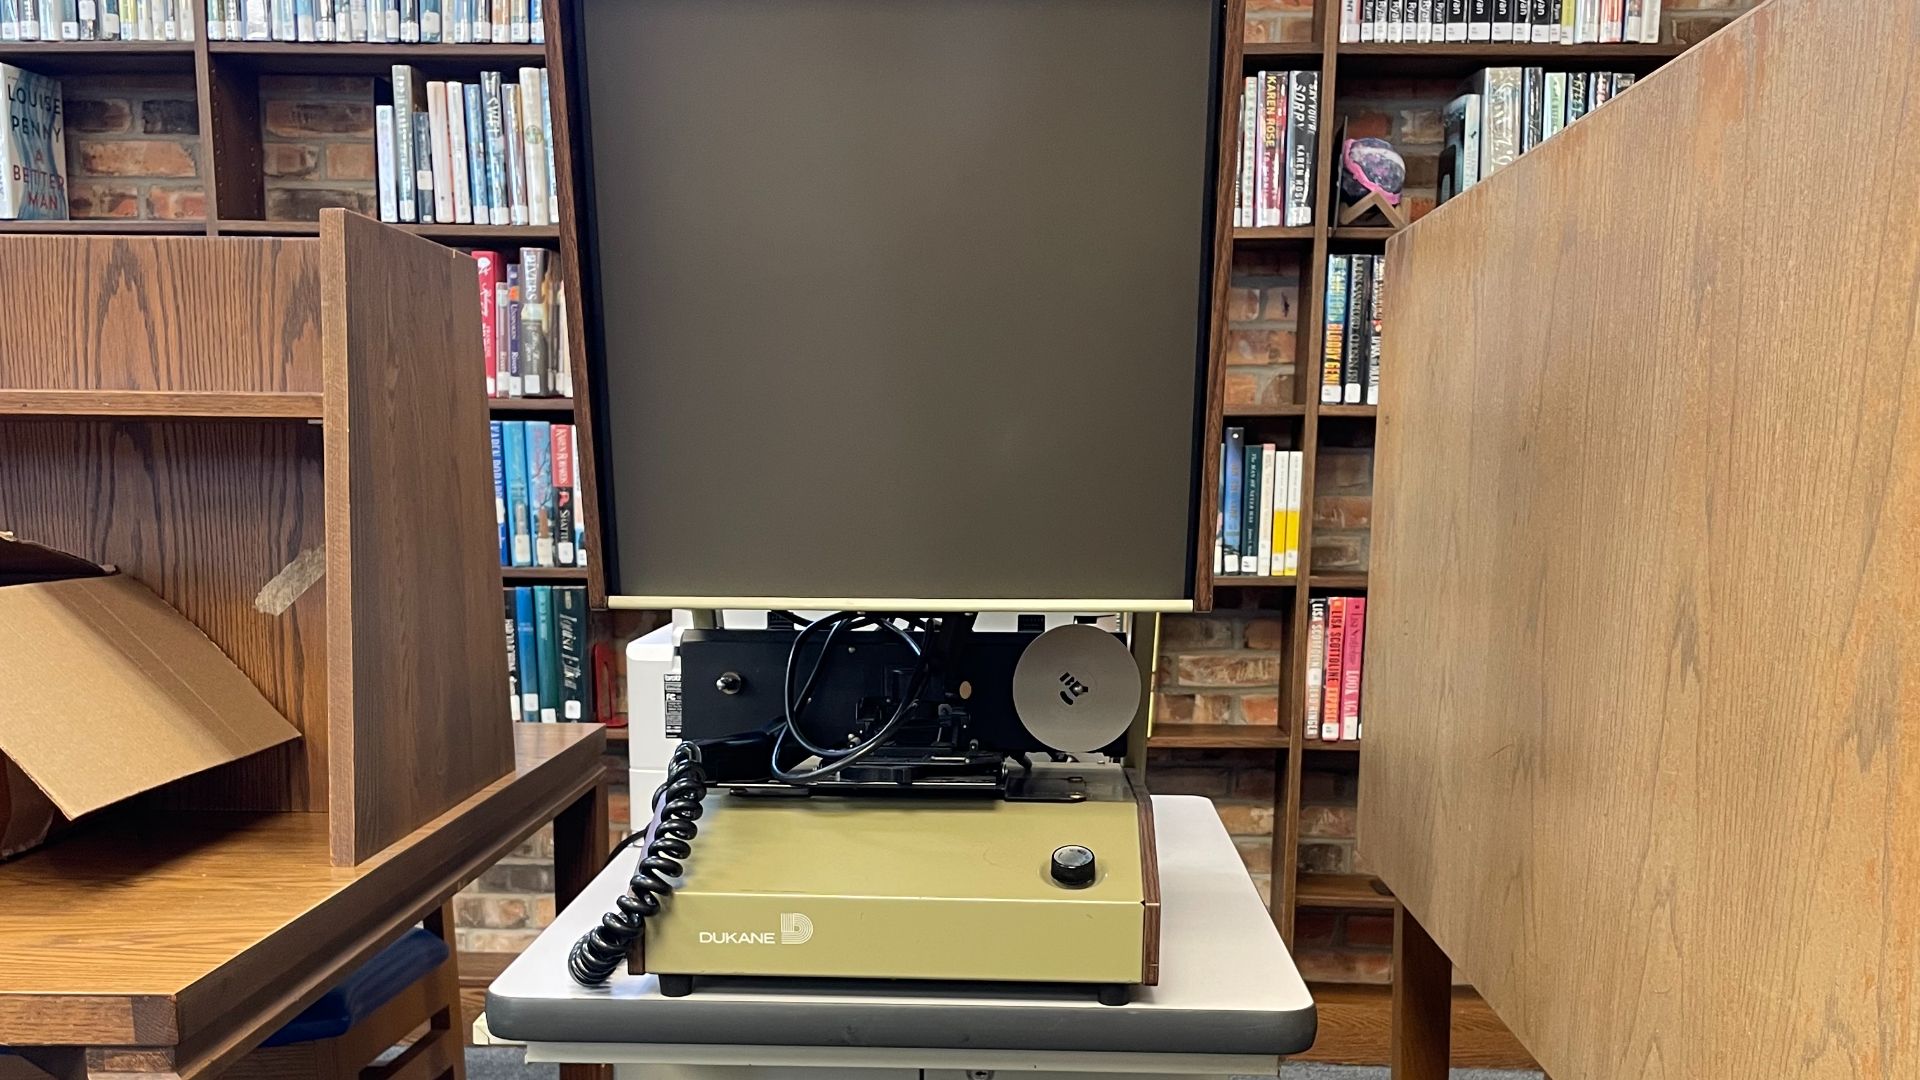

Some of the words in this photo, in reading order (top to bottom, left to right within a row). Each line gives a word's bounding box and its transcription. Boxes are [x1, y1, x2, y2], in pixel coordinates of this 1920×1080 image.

[1436, 2, 1445, 22] Ryan
[7, 83, 62, 115] LOUISE
[1266, 75, 1277, 113] KAREN
[1294, 84, 1306, 132] SORRY
[11, 115, 62, 143] PENNY
[1265, 114, 1276, 147] ROSE
[34, 150, 44, 164] A
[1295, 145, 1305, 176] KAREN
[13, 165, 65, 191] BETTER
[28, 191, 58, 211] MAN
[524, 252, 538, 300] RIVERS
[1326, 324, 1343, 360] BLOODY
[1323, 361, 1340, 384] GENI
[1311, 603, 1324, 621] LISA
[1330, 610, 1342, 628] LISA
[1327, 632, 1341, 682] SCOTTOLINE
[1344, 670, 1359, 696] LOOK
[1325, 687, 1340, 722] EXPOSE
[1343, 699, 1358, 717] AGA
[699, 931, 776, 945] DUKANE
